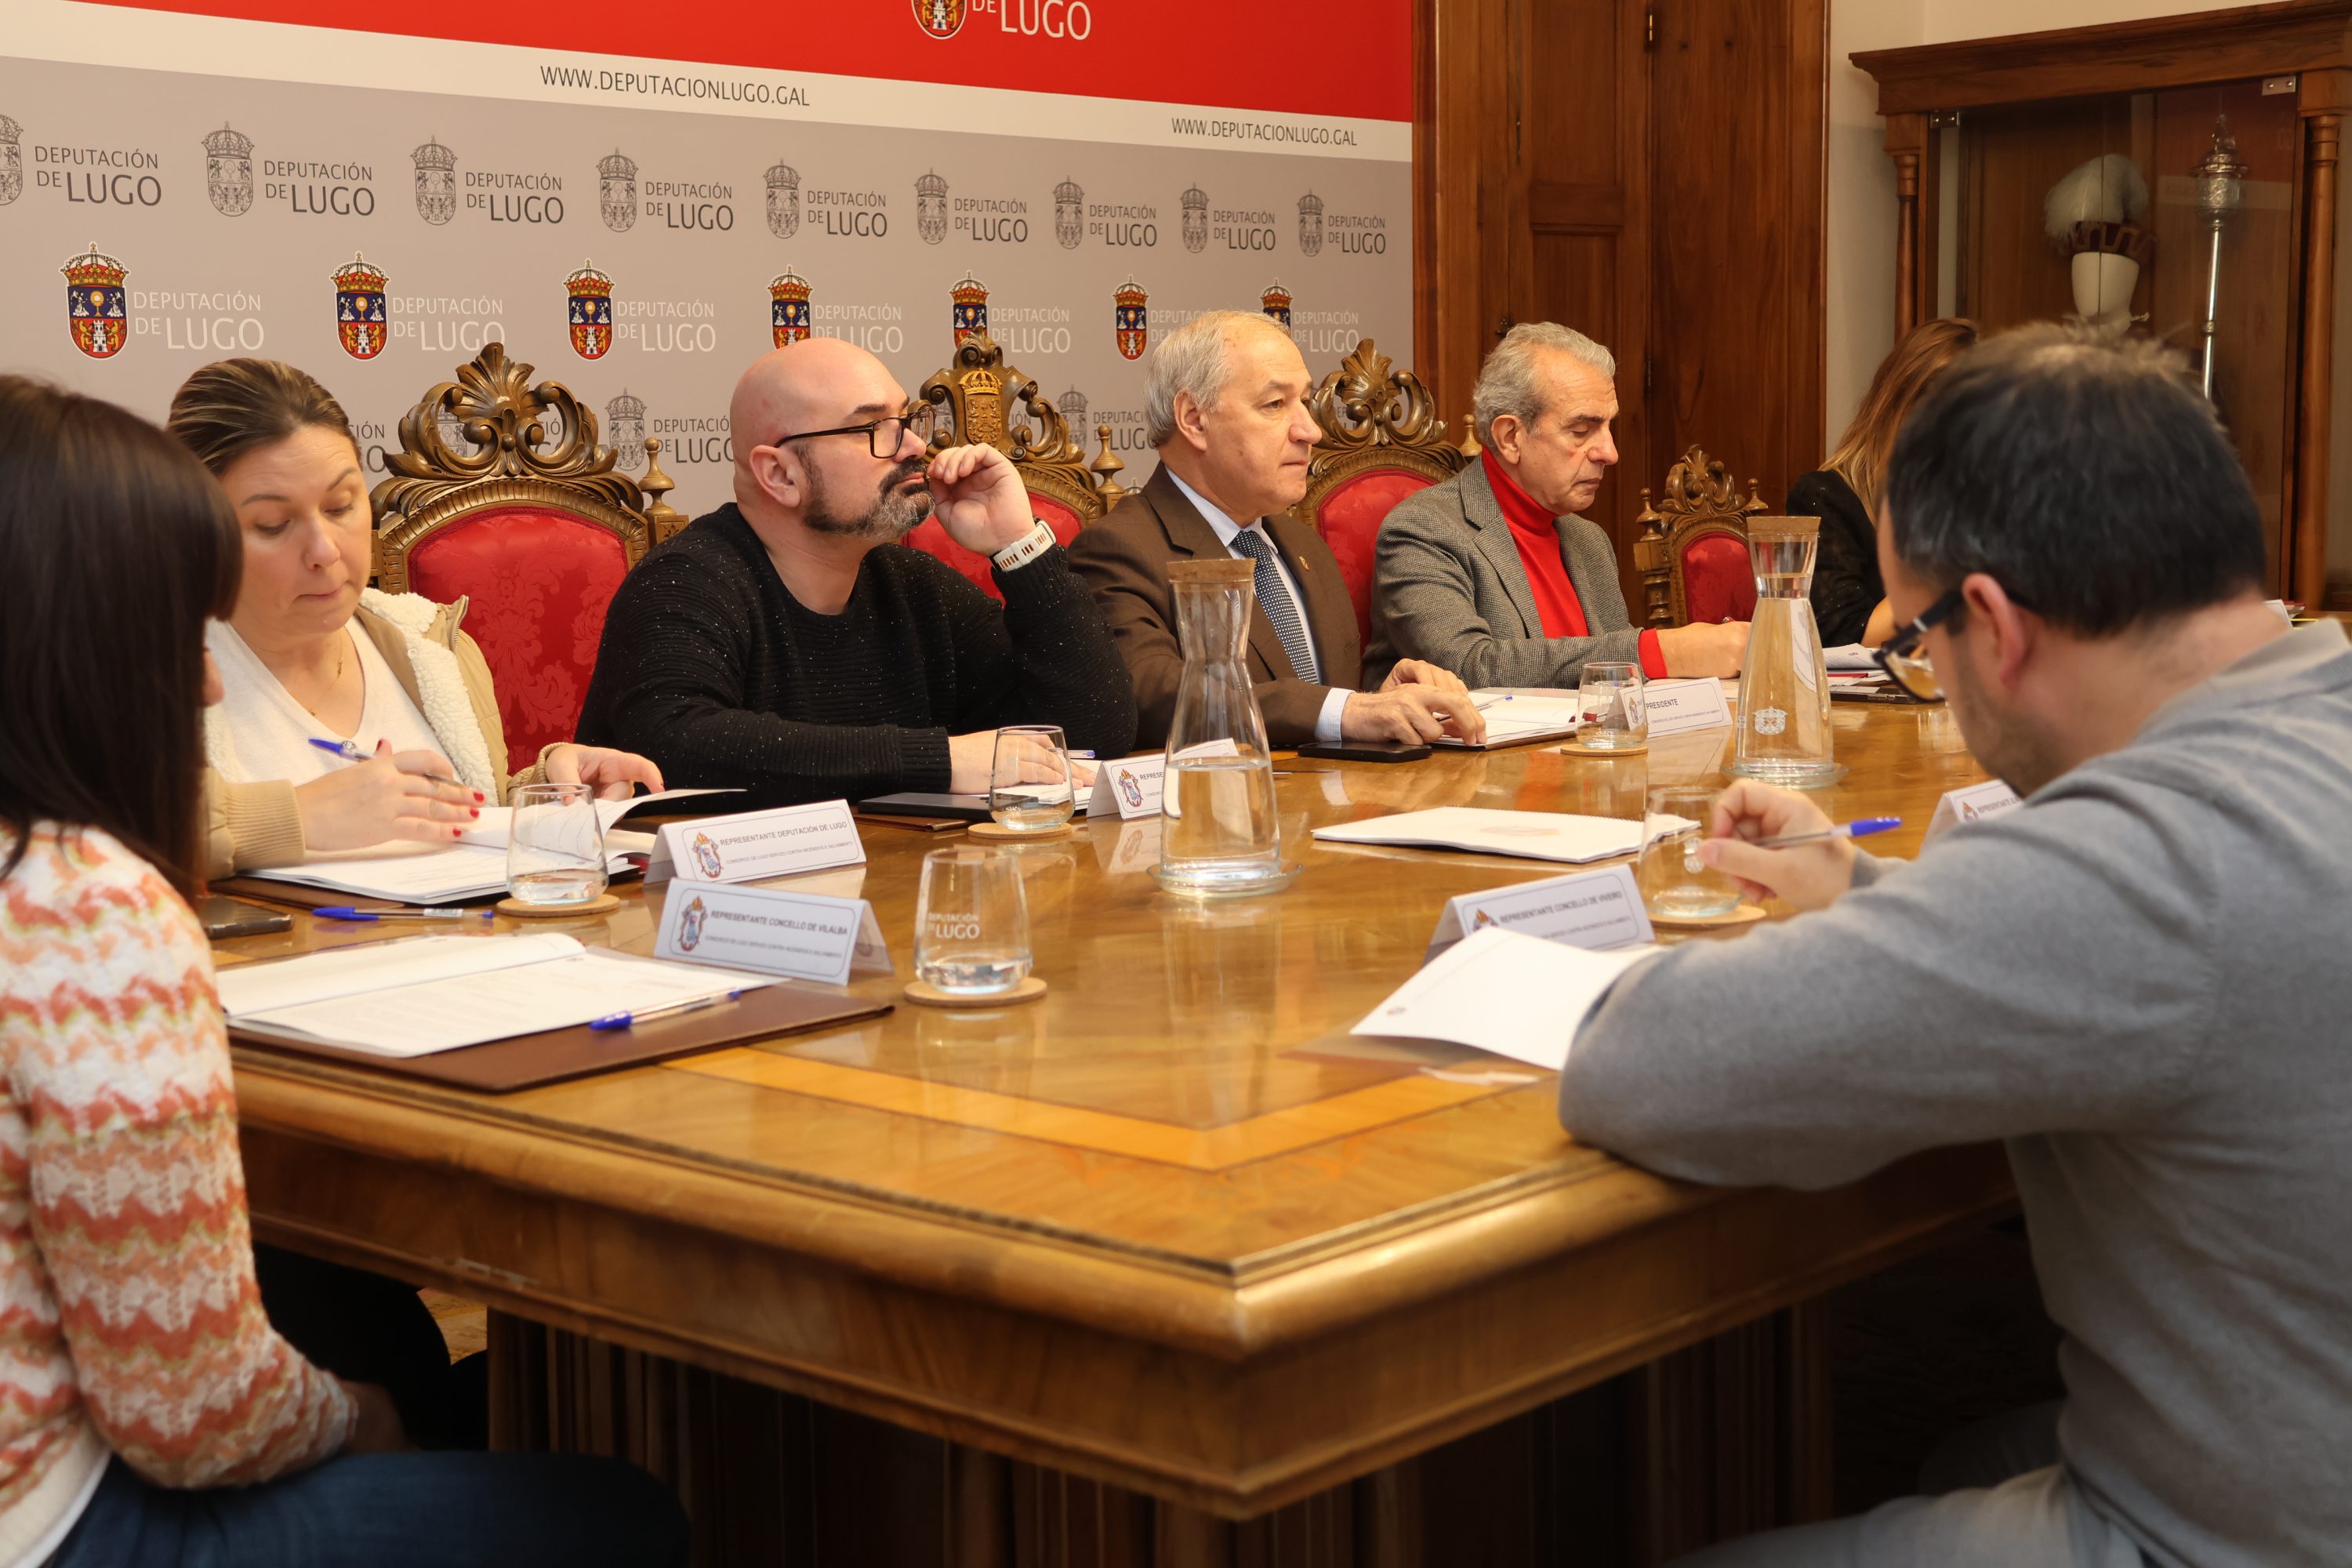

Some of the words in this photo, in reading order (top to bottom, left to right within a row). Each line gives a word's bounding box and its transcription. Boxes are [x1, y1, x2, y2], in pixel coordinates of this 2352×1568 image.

[1000, 0, 1091, 40] LUGO
[540, 65, 810, 107] WWW.DEPUTACIONLUGO.GAL
[1171, 117, 1357, 147] WWW.DEPUTACIONLUGO.GAL
[35, 146, 158, 169] DEPUTACIÓN
[264, 160, 372, 181] DEPUTACIÓN
[466, 172, 562, 191] DEPUTACIÓN
[37, 170, 62, 187] DE
[67, 172, 162, 206] LUGO
[645, 181, 732, 199] DEPUTACIÓN
[808, 190, 886, 208] DEPUTACIÓN
[265, 183, 288, 199] DE
[292, 184, 375, 216] LUGO
[466, 194, 486, 209] DE
[490, 194, 564, 224] LUGO
[955, 198, 1026, 214] DEPUTACIÓN
[646, 202, 664, 216] DE
[666, 203, 734, 231] LUGO
[1090, 204, 1156, 220] DEPUTACIÓN
[1214, 209, 1275, 224] DEPUTACIÓN
[1328, 215, 1385, 229] DEPUTACIÓN
[808, 210, 824, 223] DE
[827, 211, 887, 237] LUGO
[955, 217, 970, 230] DE
[972, 217, 1028, 242] LUGO
[1090, 223, 1103, 234] DE
[1105, 223, 1157, 247] LUGO
[1214, 228, 1226, 239] DE
[1229, 228, 1276, 250] LUGO
[1328, 232, 1340, 243] DE
[1342, 233, 1386, 254] LUGO
[133, 289, 261, 311] DEPUTACIÓN
[392, 295, 503, 314] DEPUTACIÓN
[618, 299, 714, 318] DEPUTACIÓN
[815, 303, 902, 321] DEPUTACIÓN
[992, 306, 1069, 322] DEPUTACIÓN
[1150, 310, 1203, 324] DEPUTAC
[1294, 310, 1359, 325] DEPUTACIÓN
[135, 318, 161, 335] DE
[166, 317, 264, 350] LUGO
[394, 321, 416, 337] DE
[420, 321, 505, 351] LUGO
[619, 324, 637, 339] DE
[641, 324, 716, 353] LUGO
[992, 328, 1008, 342] DE
[1011, 328, 1071, 353] LUGO
[1294, 330, 1308, 342] DE
[1309, 329, 1359, 353] LUGO
[654, 415, 729, 433] DEPUTACIÓ
[1093, 411, 1144, 423] DEPUTACI
[1646, 699, 1679, 710] PRESIDENTE
[720, 833, 777, 846] REPRESENTANTE
[779, 826, 818, 837] DEPUTACIÓN
[830, 821, 848, 829] LUGO
[711, 910, 768, 925] REPRESENTANTE
[769, 917, 806, 931] CONCELLO
[807, 922, 818, 931] DE
[818, 924, 848, 935] VILALBA
[936, 924, 980, 939] LUGO
